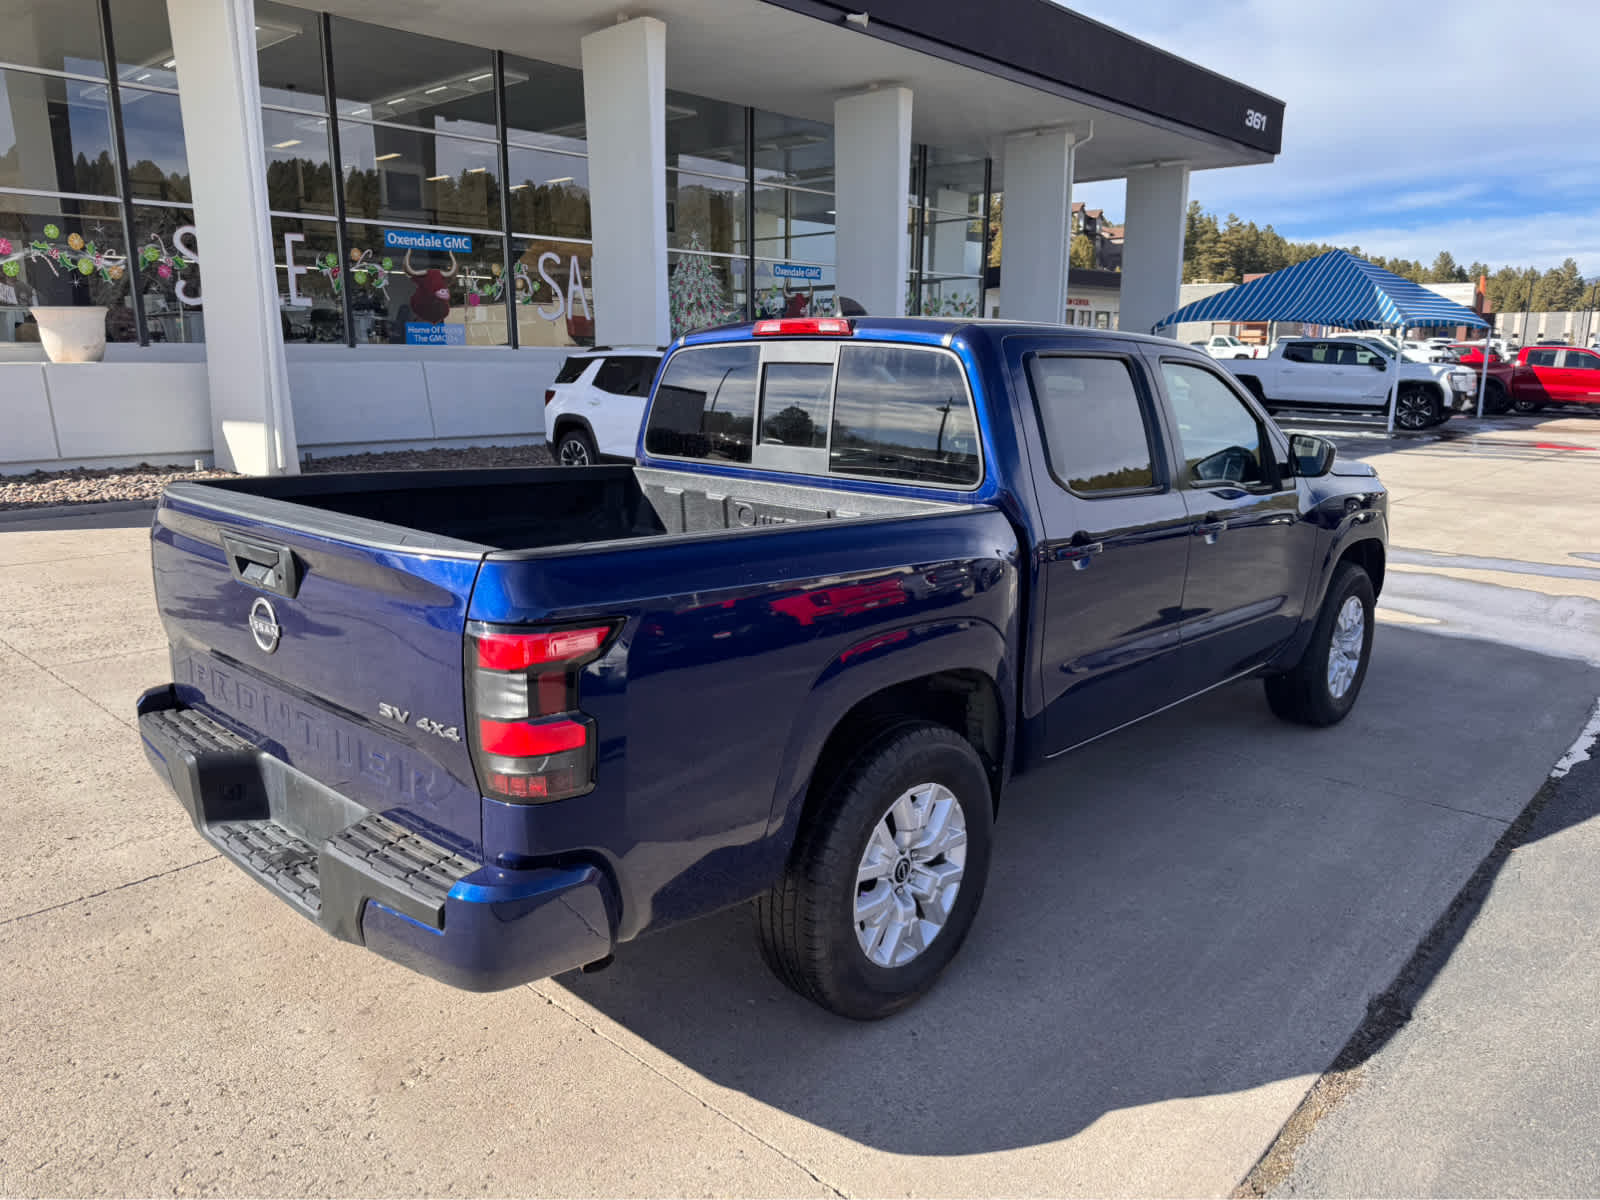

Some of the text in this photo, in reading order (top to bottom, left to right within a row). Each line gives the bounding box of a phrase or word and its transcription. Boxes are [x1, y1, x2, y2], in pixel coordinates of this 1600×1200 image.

[1245, 109, 1267, 131] 361
[387, 232, 470, 249] Oxendale GMC
[537, 251, 593, 321] SA
[379, 702, 410, 724] SV
